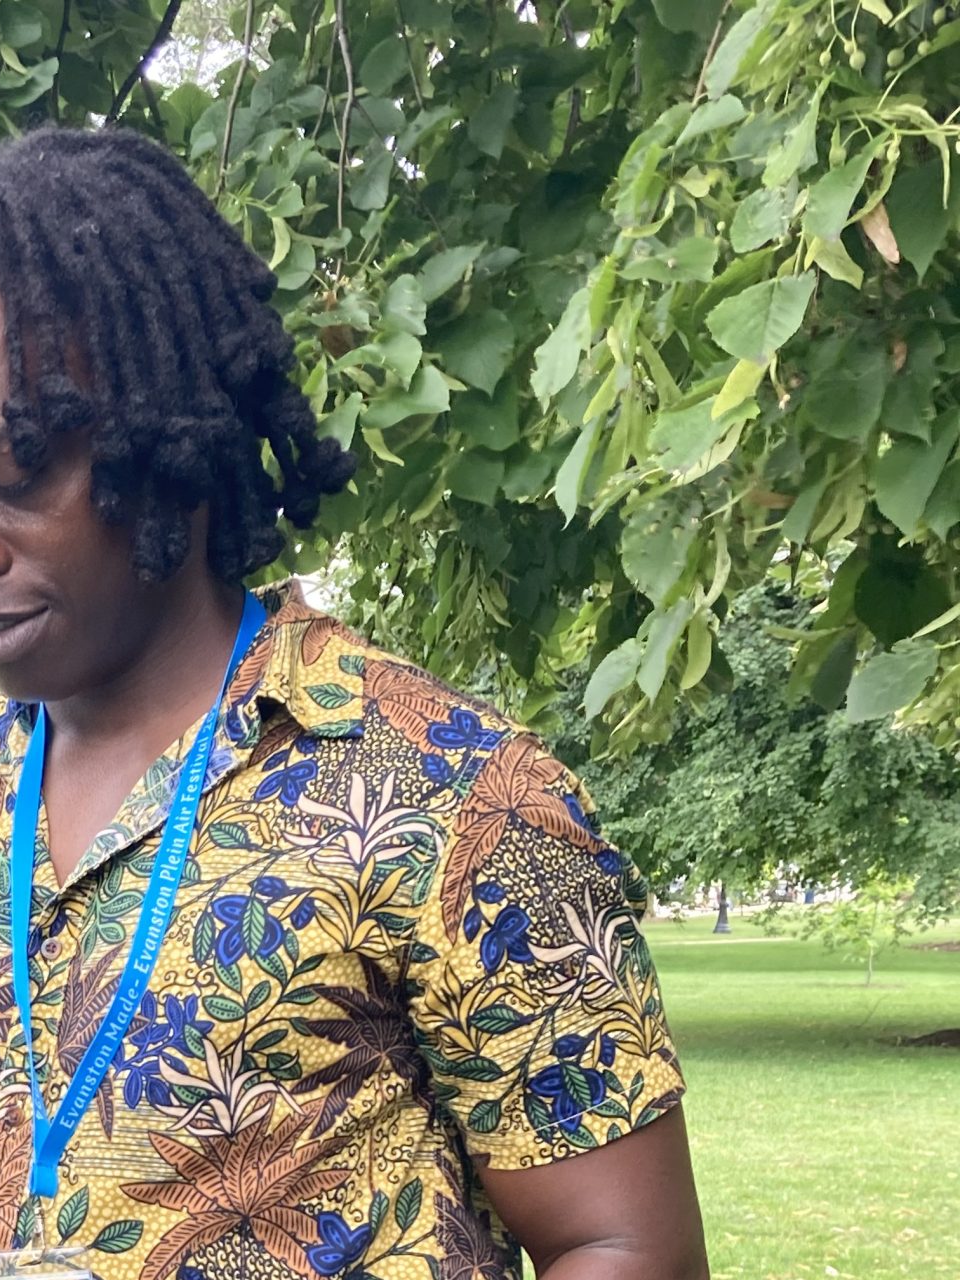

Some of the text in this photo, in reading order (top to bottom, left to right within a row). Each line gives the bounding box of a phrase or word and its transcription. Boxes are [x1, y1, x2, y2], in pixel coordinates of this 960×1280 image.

[181, 736, 209, 803] Festival
[173, 807, 192, 834] Air
[159, 838, 185, 882] Plein
[133, 887, 173, 974] Evanston
[59, 1043, 113, 1129] Evanston
